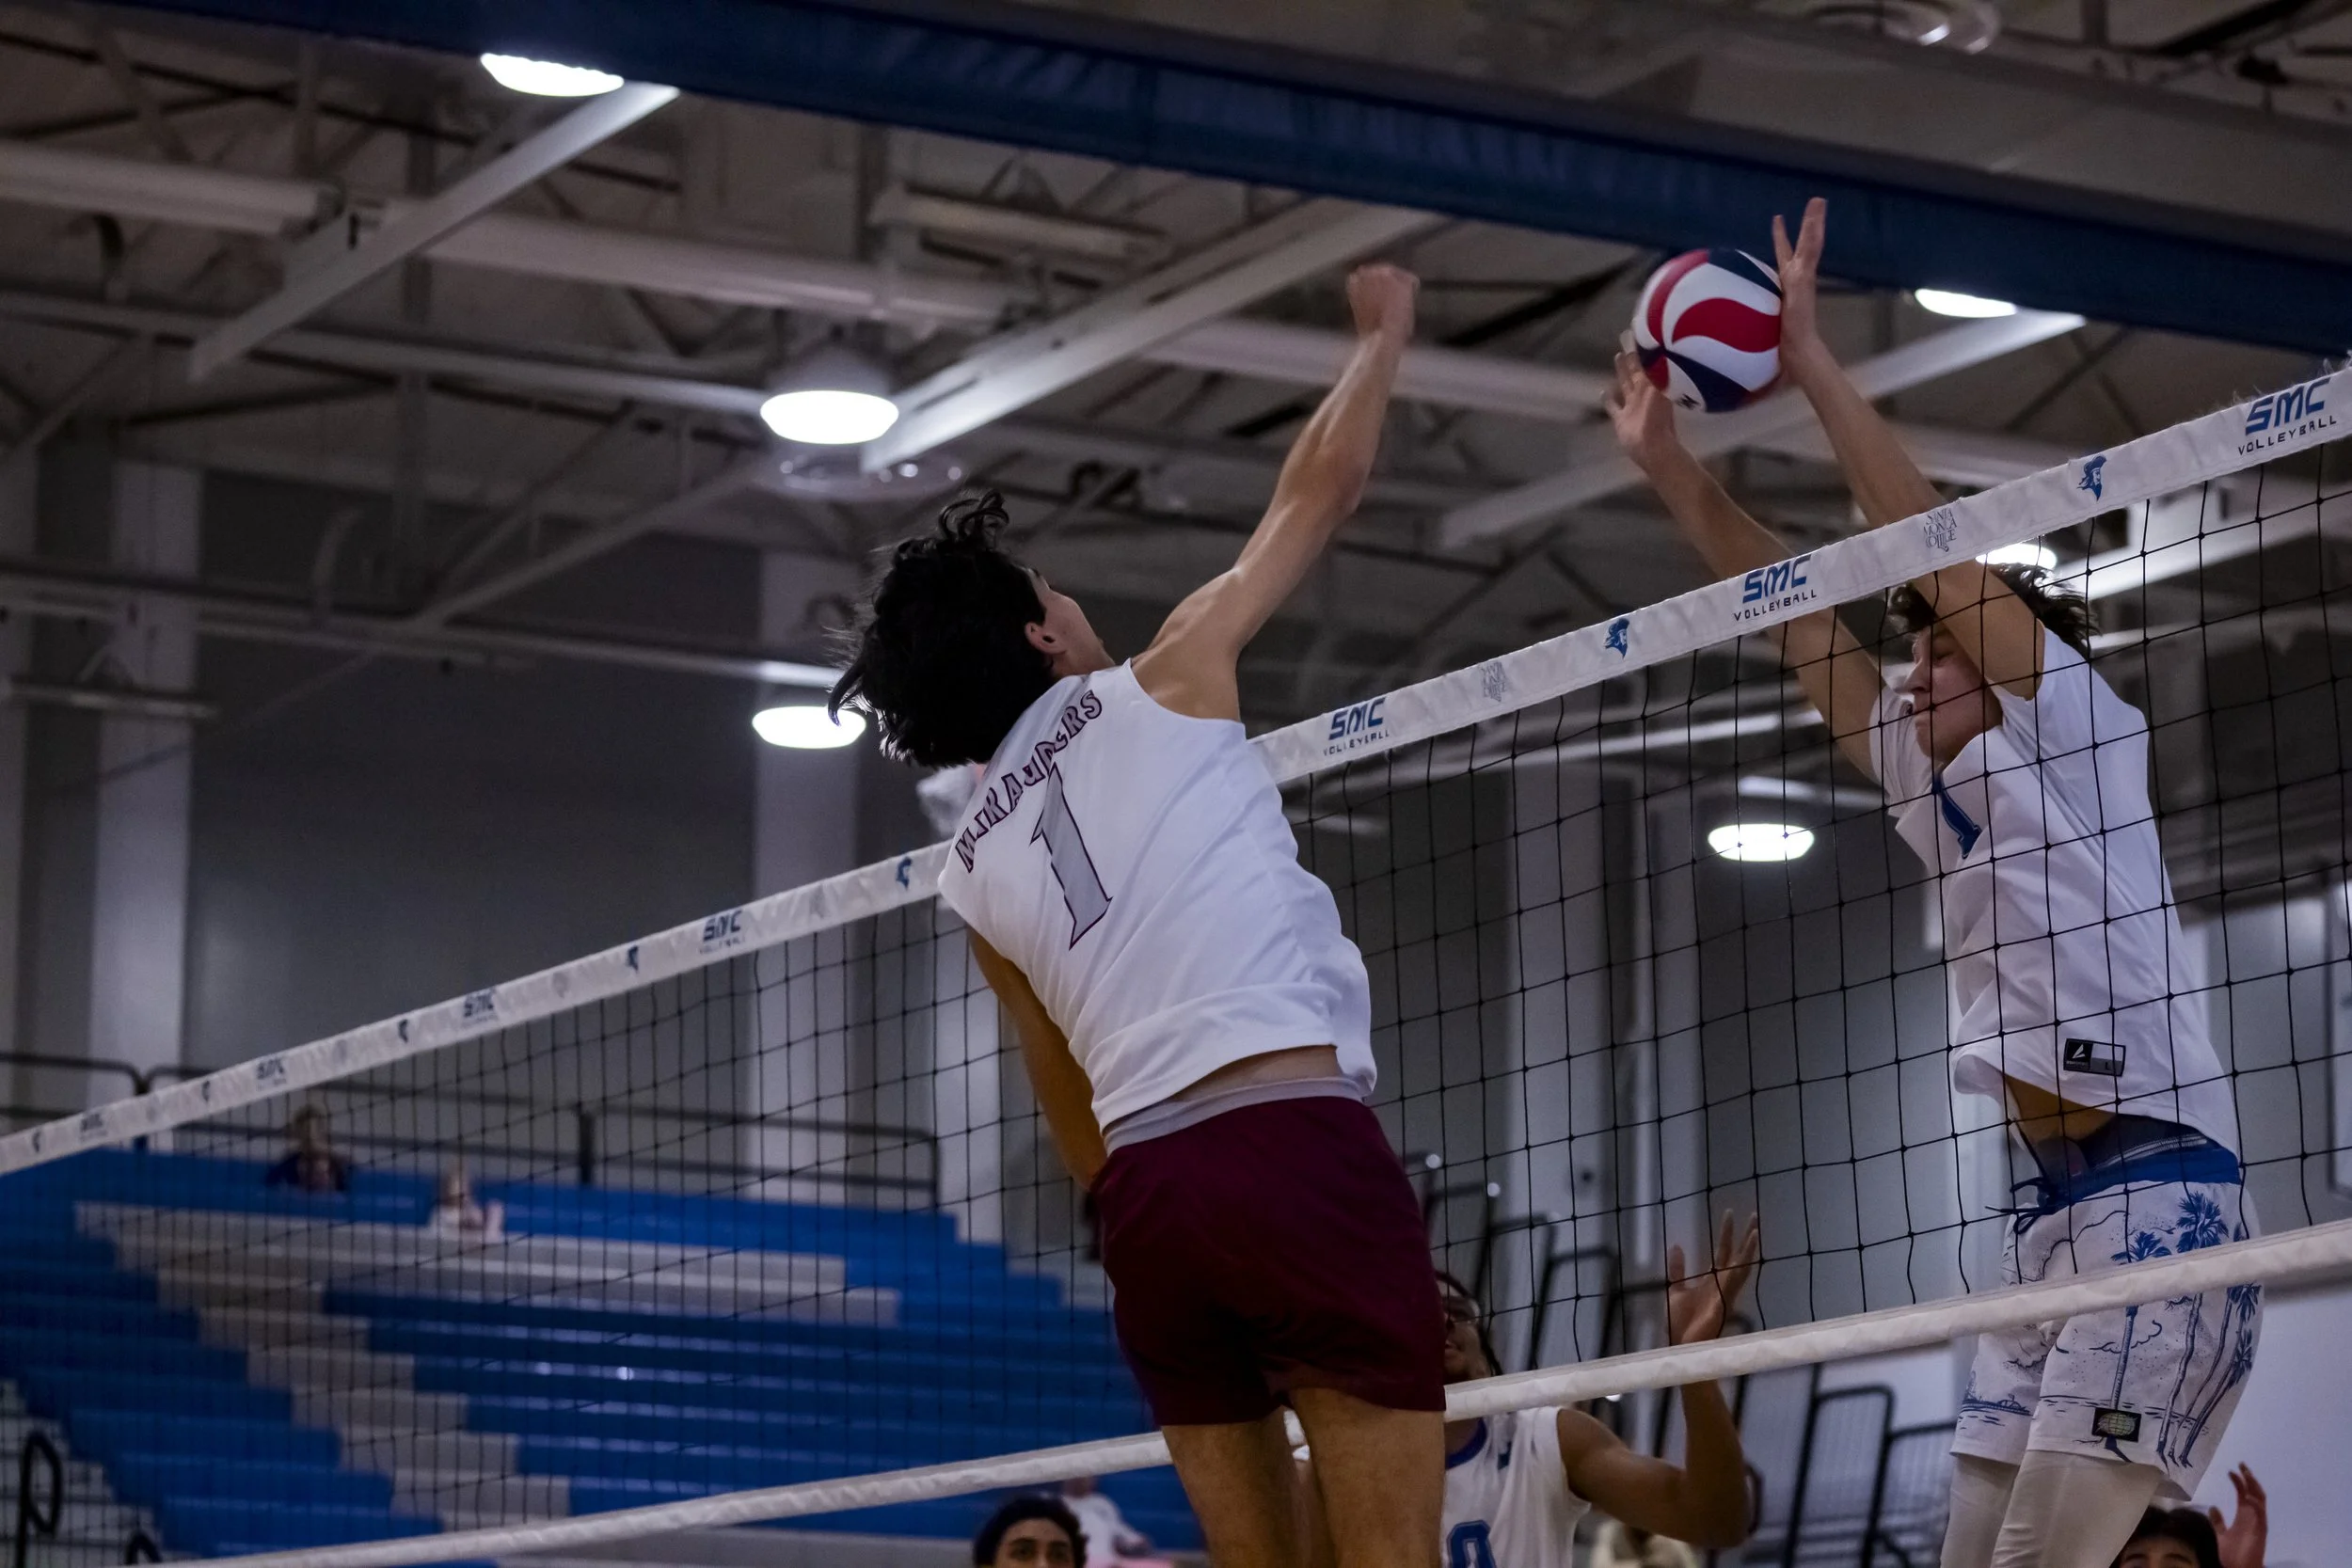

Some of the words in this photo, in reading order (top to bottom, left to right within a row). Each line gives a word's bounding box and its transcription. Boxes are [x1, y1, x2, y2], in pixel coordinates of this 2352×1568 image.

[2246, 377, 2330, 436] SMC
[2238, 415, 2337, 455] VOLLEYBALL
[1742, 554, 1812, 604] SMC
[1734, 589, 1817, 621] VOLLEYBALL
[1328, 697, 1386, 740] SMC
[1029, 761, 1113, 951] 1
